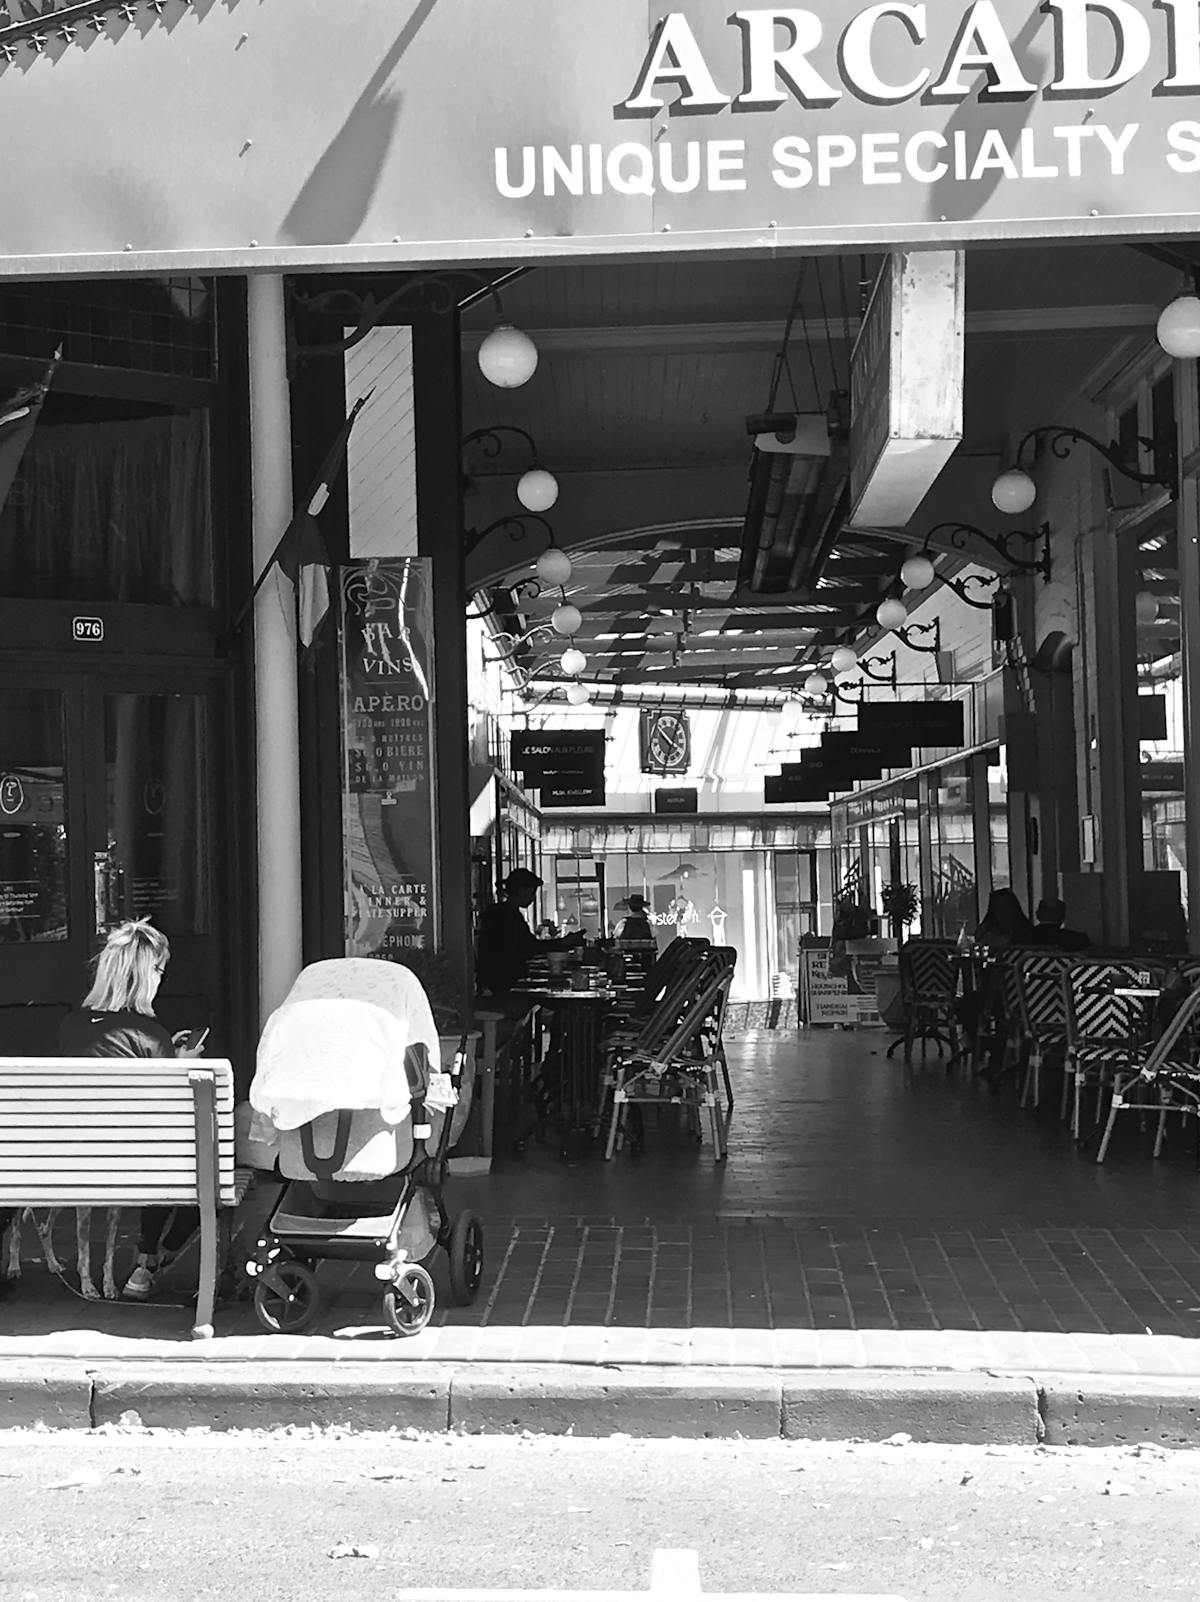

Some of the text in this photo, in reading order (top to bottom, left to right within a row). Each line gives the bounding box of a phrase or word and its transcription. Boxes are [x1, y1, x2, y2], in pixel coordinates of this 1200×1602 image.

[495, 140, 746, 198] UNIQUE
[771, 123, 1140, 188] SPECIALTY
[76, 622, 100, 636] 976
[363, 658, 413, 675] VINS
[352, 692, 424, 713] APÈRO
[398, 760, 424, 771] VIN
[371, 885, 385, 896] LA
[391, 884, 427, 895] CARTE
[419, 896, 427, 906] &
